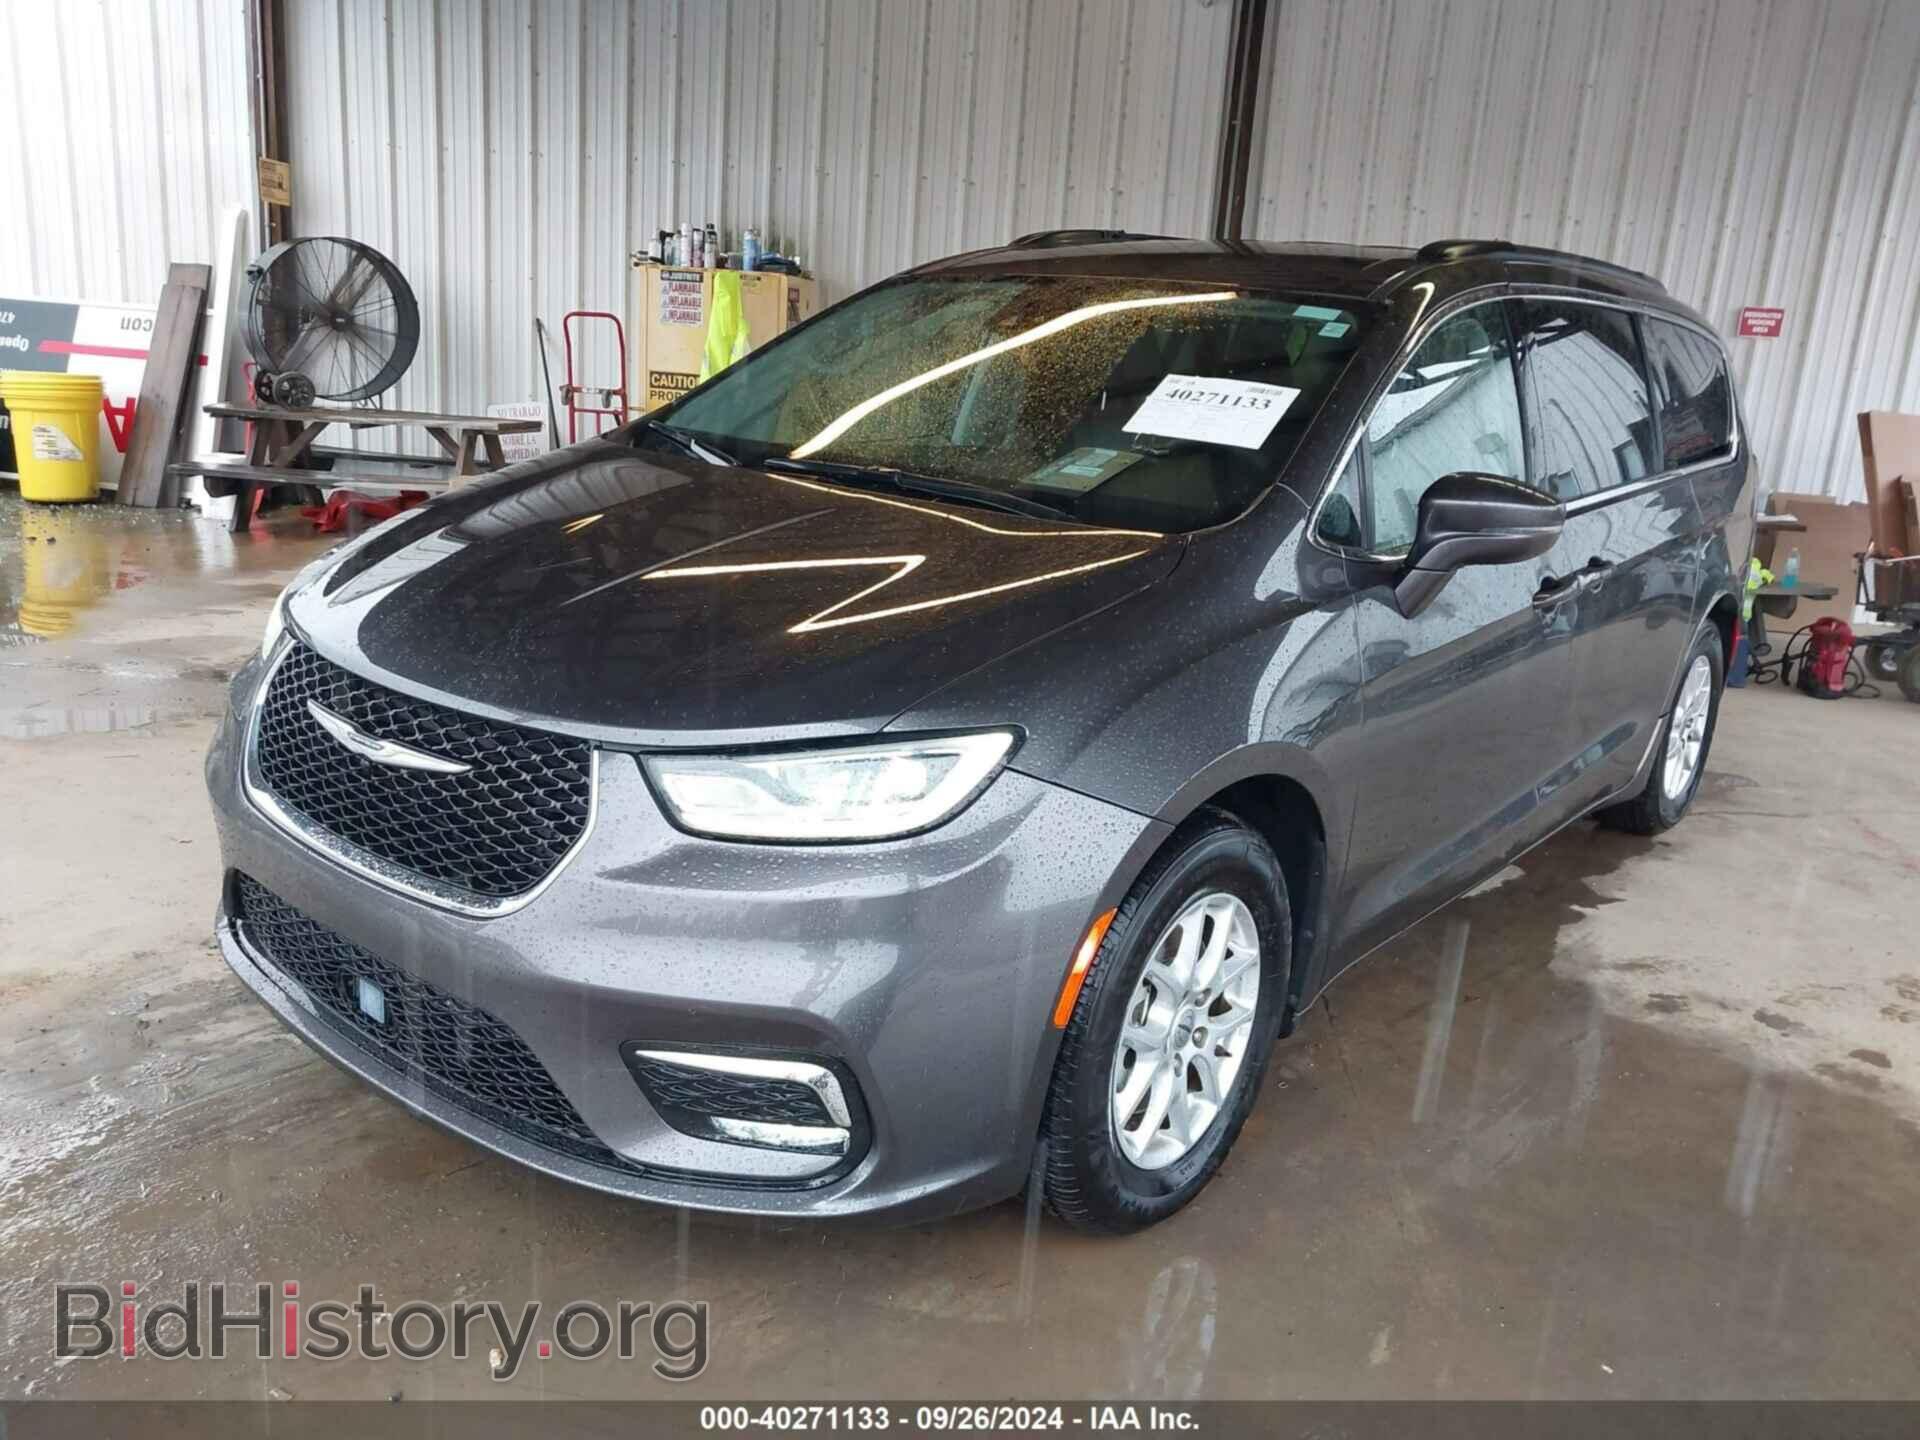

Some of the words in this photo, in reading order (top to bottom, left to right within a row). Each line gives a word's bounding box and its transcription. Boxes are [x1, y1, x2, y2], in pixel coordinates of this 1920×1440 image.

[651, 373, 697, 389] CAUTIO
[1165, 388, 1271, 410] 40271133
[502, 447, 541, 460] ROPIEDAD
